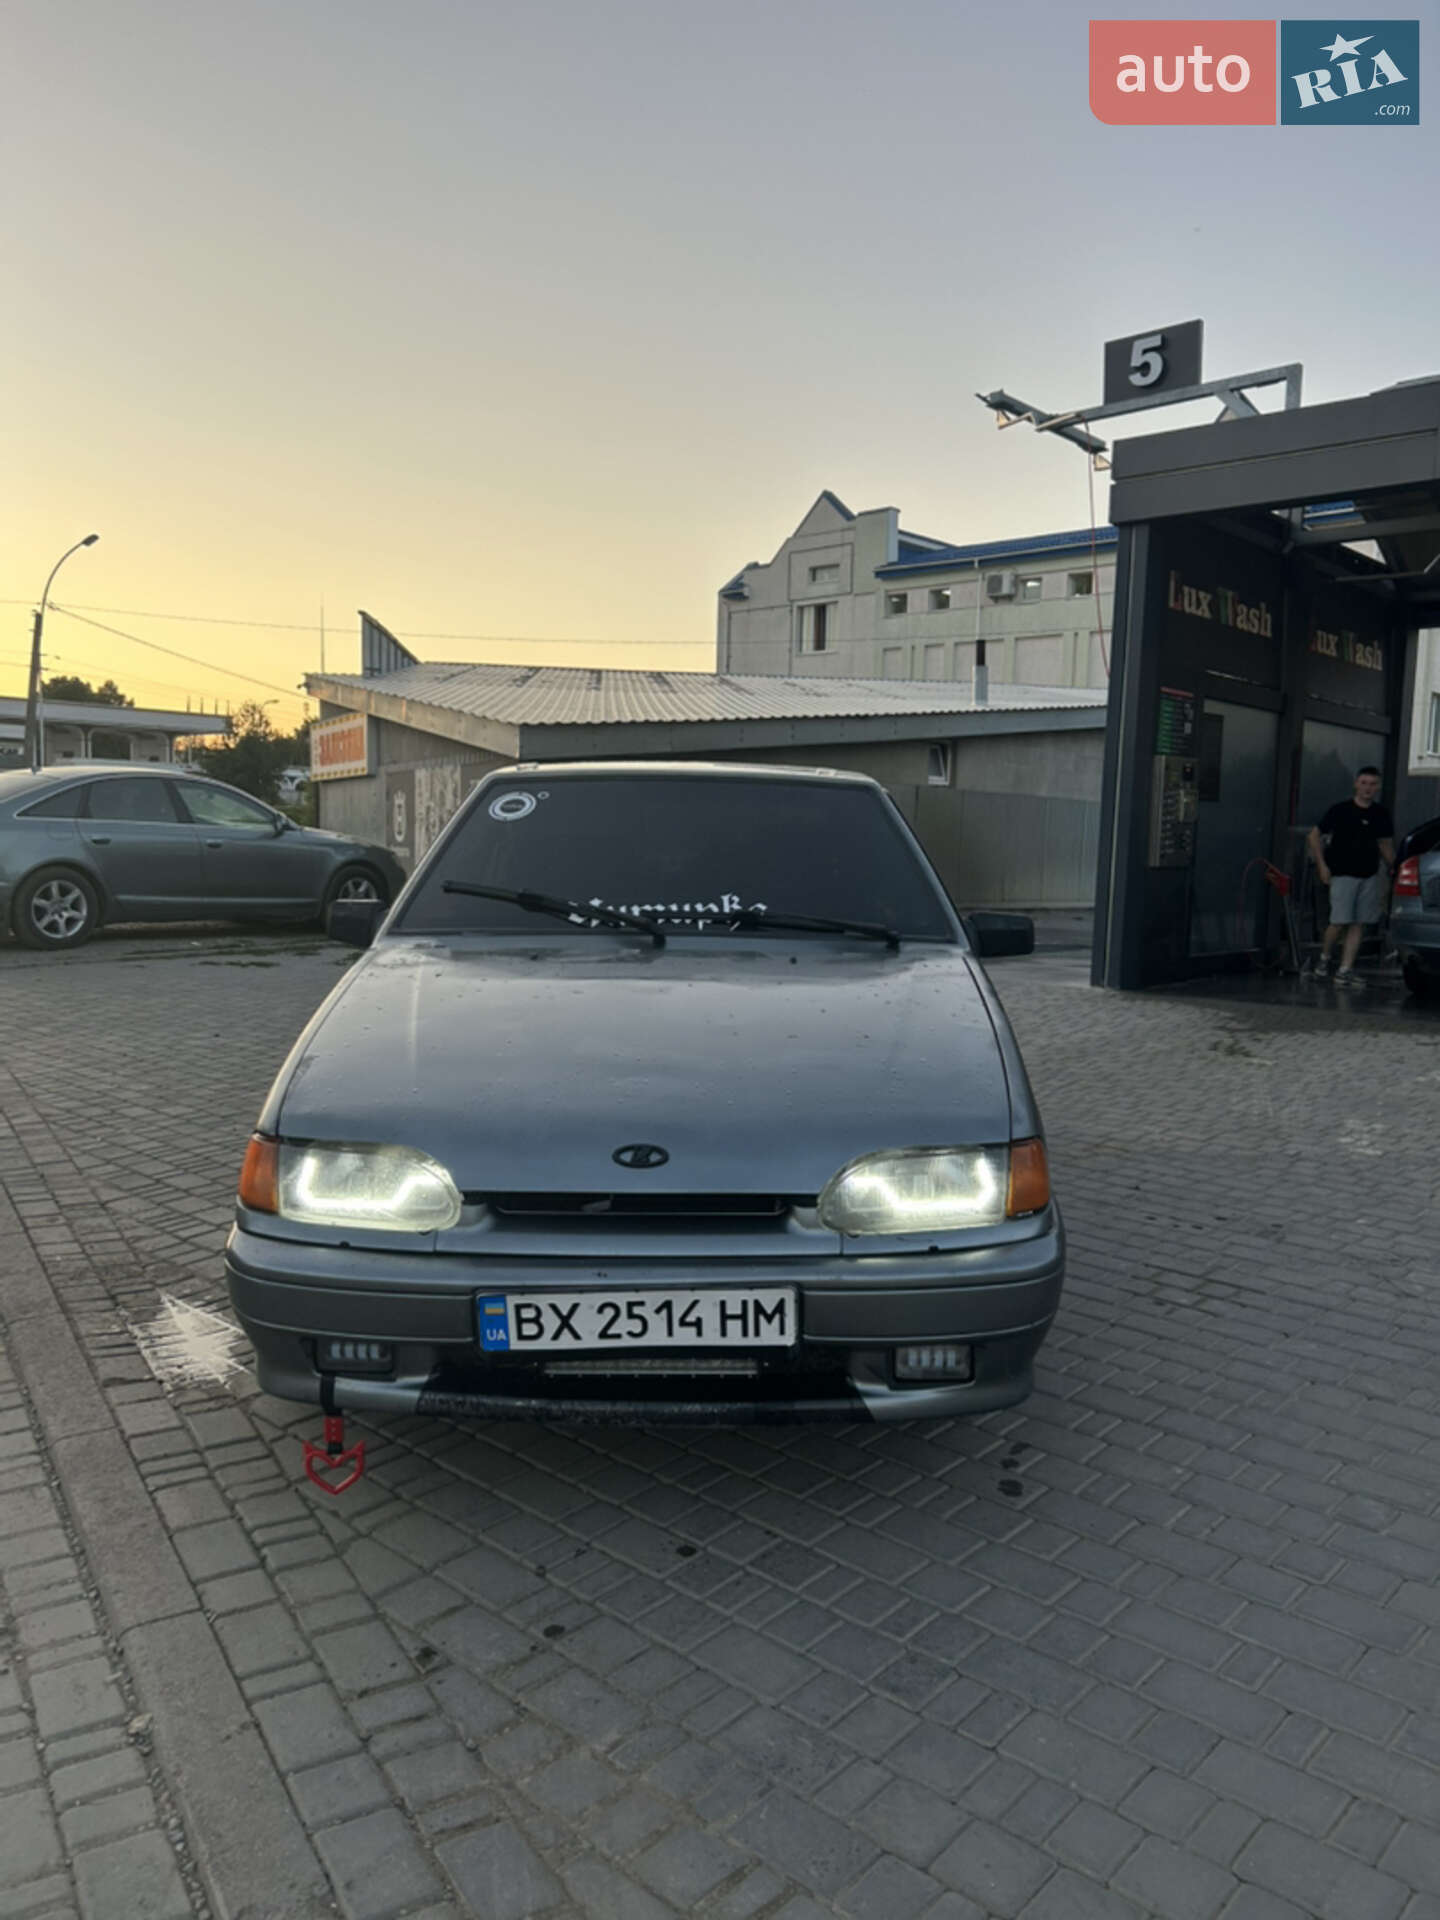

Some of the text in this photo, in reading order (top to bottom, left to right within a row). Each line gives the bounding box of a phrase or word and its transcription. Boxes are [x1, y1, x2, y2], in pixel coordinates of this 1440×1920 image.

[1128, 333, 1164, 387] 5
[1168, 569, 1213, 620] Lux
[486, 1328, 507, 1341] UA
[513, 1297, 787, 1342] BX 2514 HM
